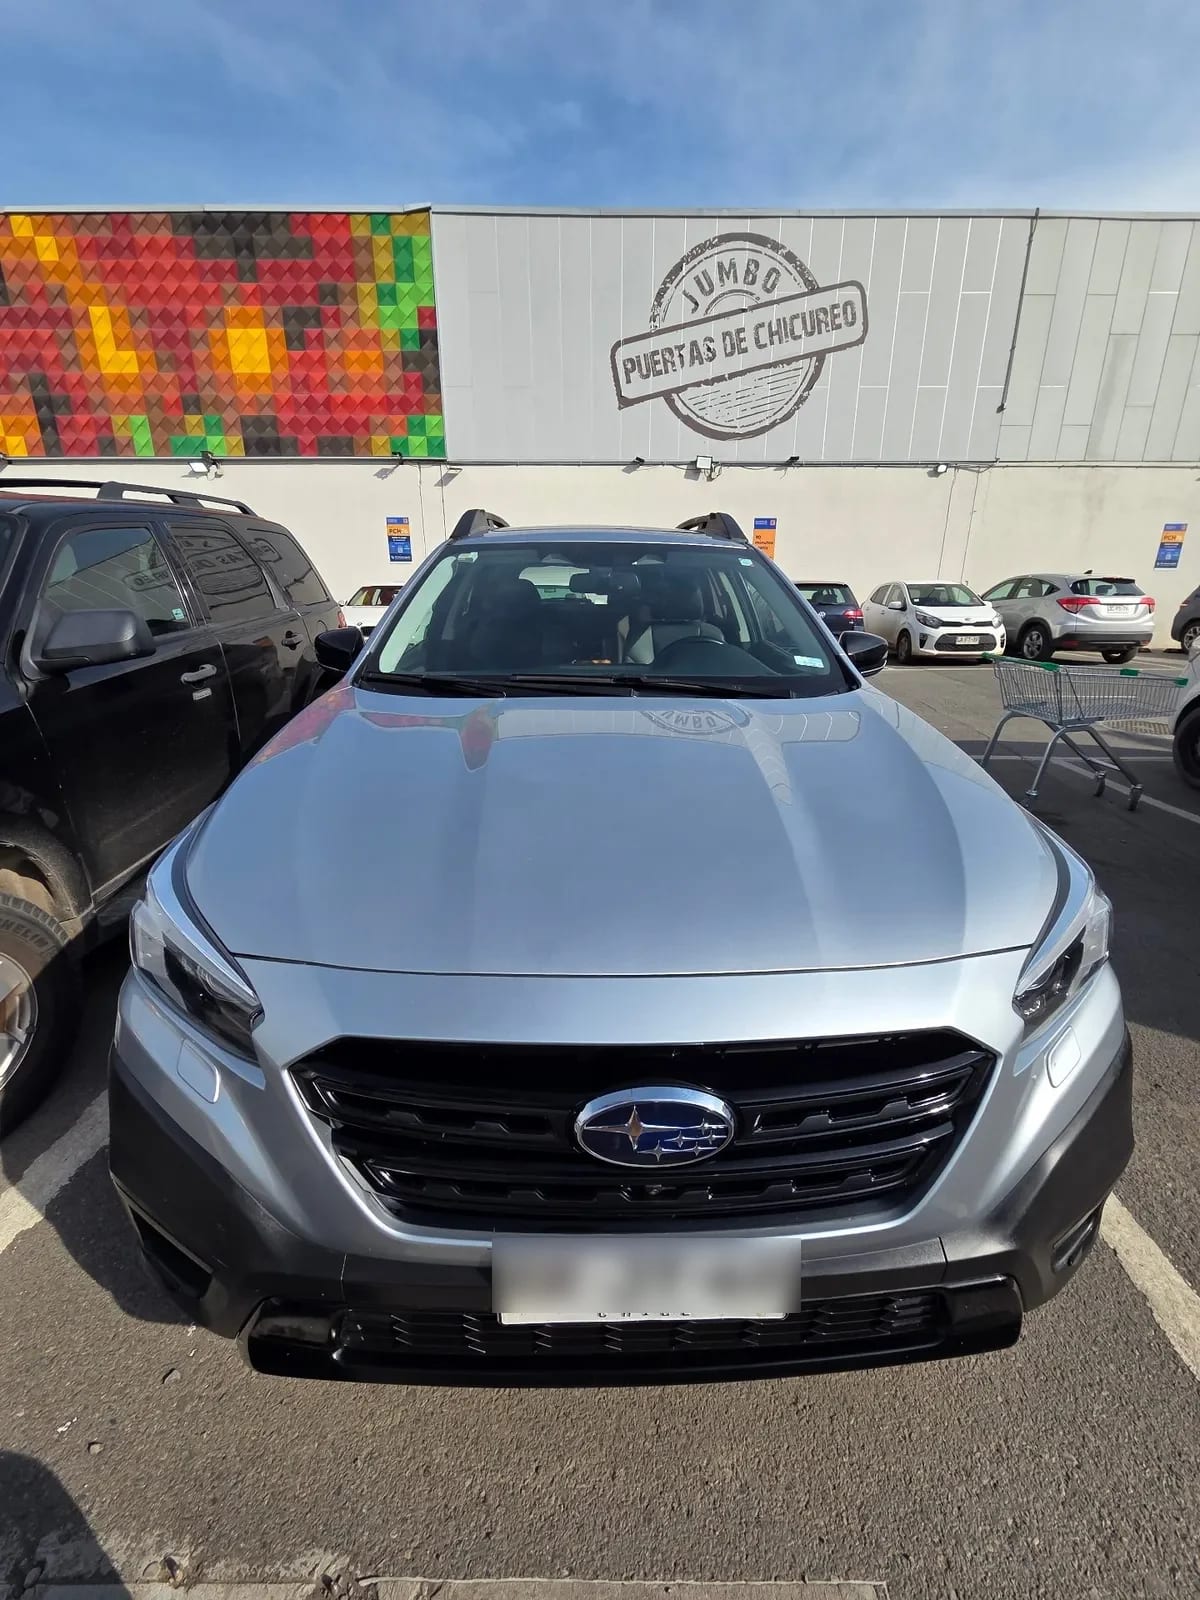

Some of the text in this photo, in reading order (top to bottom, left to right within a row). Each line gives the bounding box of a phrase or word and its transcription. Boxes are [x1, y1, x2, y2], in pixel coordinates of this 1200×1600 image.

[682, 258, 782, 314] JUMBO
[622, 299, 857, 384] PUERTAS DE CHICUREO
